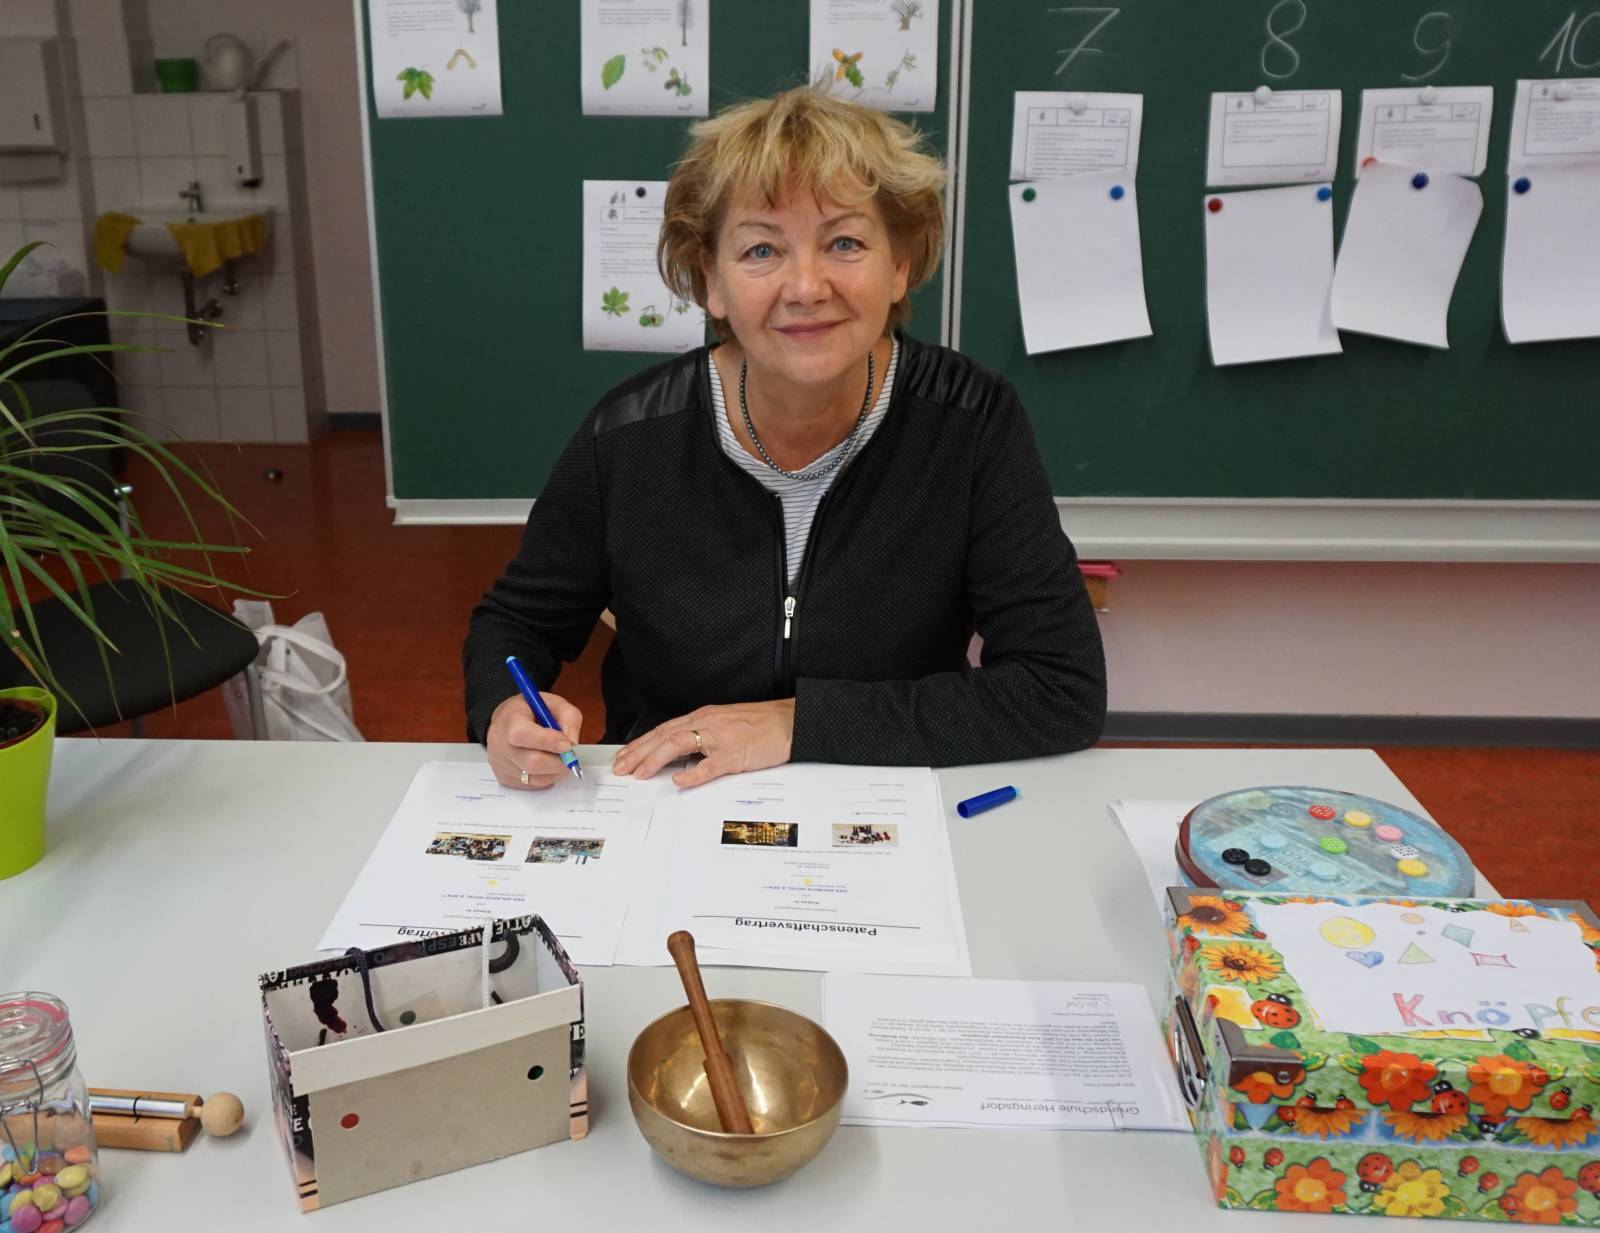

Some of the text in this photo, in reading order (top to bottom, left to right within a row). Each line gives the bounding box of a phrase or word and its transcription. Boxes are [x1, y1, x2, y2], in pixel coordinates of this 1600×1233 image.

[1047, 6, 1121, 76] 7
[1259, 0, 1308, 79] 8
[1401, 11, 1453, 81] 9
[735, 917, 878, 937] Patenschaftsvertrag
[980, 1102, 1140, 1116] Grundschule Heringsdorf
